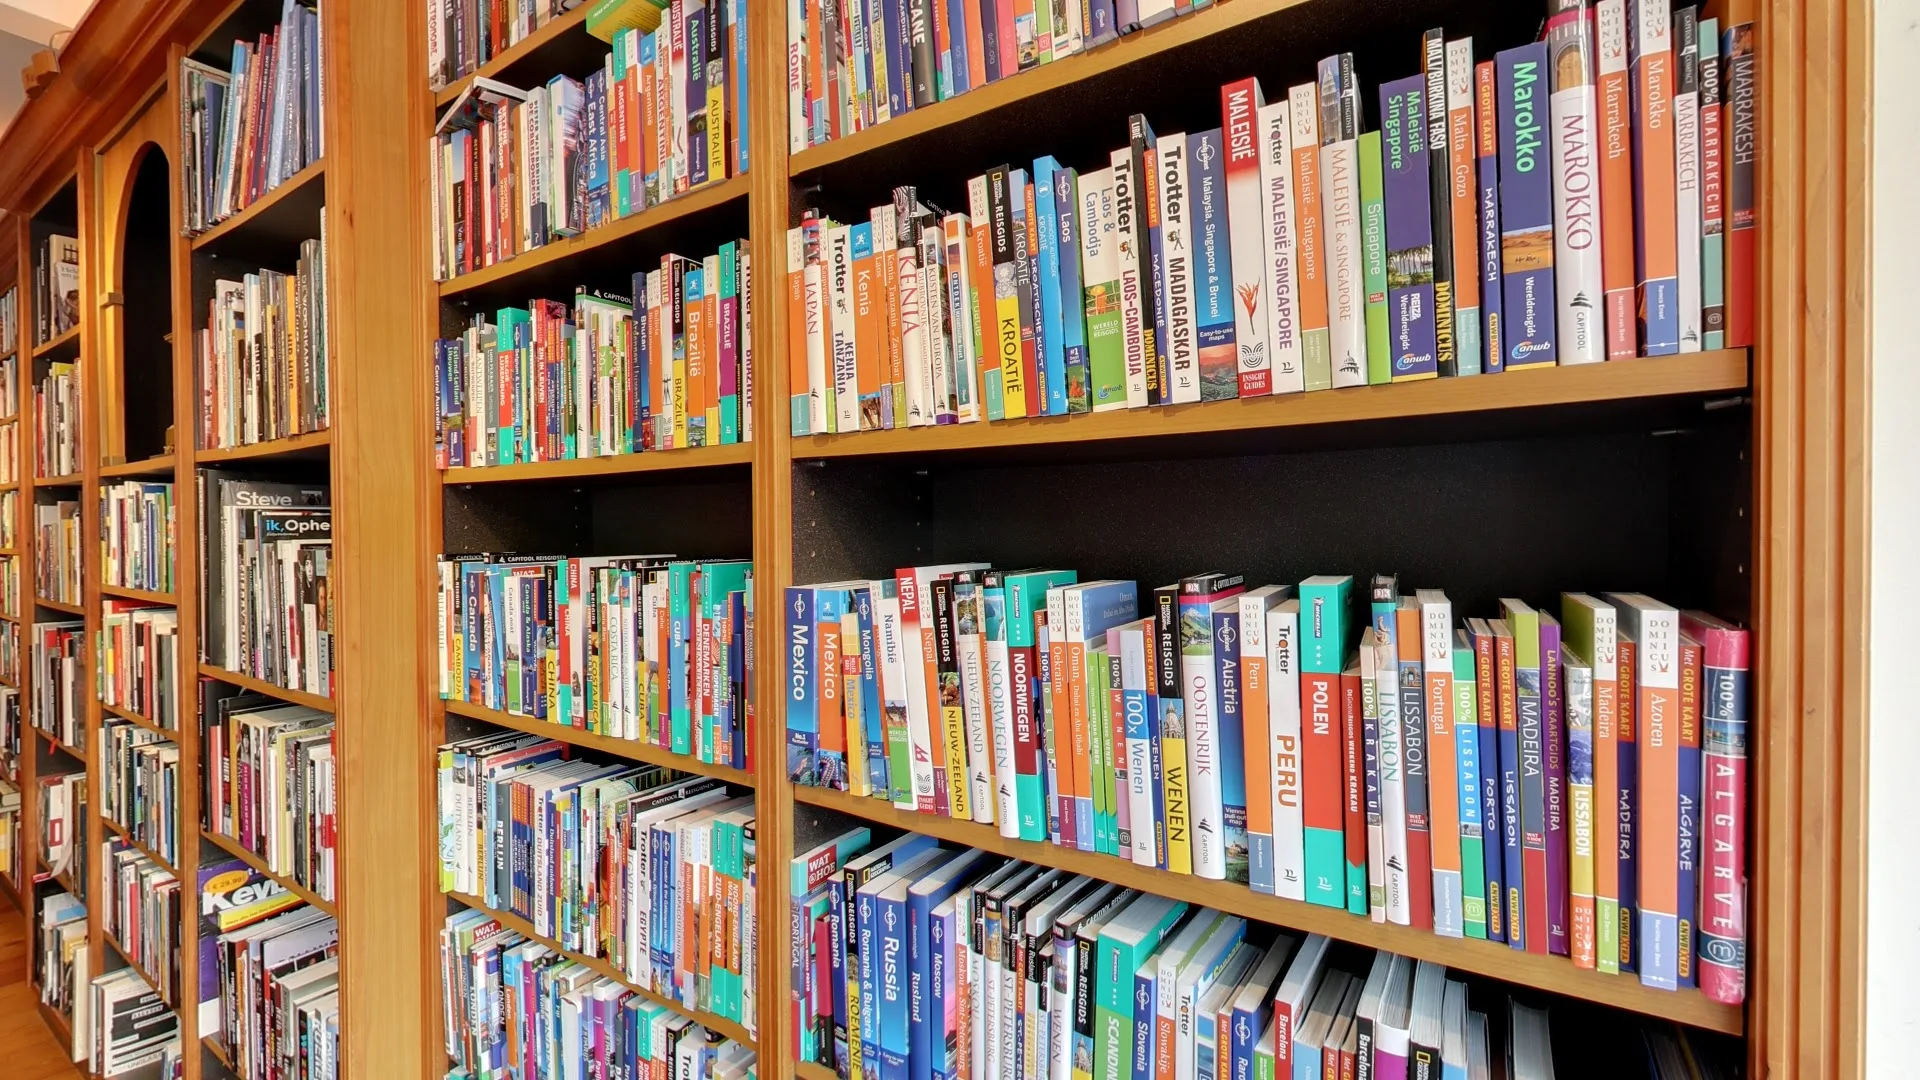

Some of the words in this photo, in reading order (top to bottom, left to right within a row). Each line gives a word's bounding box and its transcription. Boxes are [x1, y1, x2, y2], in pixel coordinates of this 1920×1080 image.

[691, 19, 701, 81] Australië
[791, 43, 799, 92] ROME
[1481, 67, 1489, 83] Met
[588, 102, 596, 135] East
[1482, 85, 1491, 117] GROTE
[1513, 61, 1541, 173] Marokko
[1606, 78, 1626, 160] Marrakech
[1648, 59, 1666, 129] Marokko
[1735, 61, 1754, 165] MARRAKESH
[711, 99, 721, 168] AUSTRALIË
[1229, 89, 1255, 162] MALEISIË
[1270, 115, 1282, 166] Trotter
[1387, 95, 1402, 170] Singapore
[1407, 91, 1423, 153] Maleisië
[1483, 118, 1492, 152] KAART
[1115, 159, 1132, 235] Trotter
[1164, 146, 1181, 224] Trotter
[1203, 176, 1213, 221] Malaysia,
[1562, 114, 1593, 252] MAROKKO
[995, 205, 1006, 253] REISGIDS
[1061, 212, 1071, 243] Laos
[1204, 223, 1217, 275] Singapore
[1367, 204, 1382, 275] Singapore
[1485, 187, 1497, 283] MARRAKECH
[834, 234, 845, 294] Trotter
[1208, 275, 1218, 285] &
[604, 292, 632, 304] CAPITOOL
[805, 283, 818, 335] JAPAN
[858, 269, 869, 316] Kenia
[900, 256, 920, 336] KENIA
[1031, 258, 1042, 332] KROATISCHE
[1169, 257, 1191, 371] MADAGASKAR
[1209, 286, 1220, 318] Brunei
[689, 311, 700, 378] Brazilië
[724, 303, 732, 349] BRAZILIË
[928, 268, 938, 307] KUSTEN
[933, 332, 942, 378] EUROPA
[1435, 281, 1452, 363] DOMINICUS
[1576, 312, 1585, 351] CAPITOOL
[835, 330, 846, 396] TANZANIA
[845, 341, 855, 380] KENIA
[1002, 317, 1021, 395] KROATIË
[1036, 335, 1044, 369] KUST
[1242, 372, 1266, 382] INSIGHT
[674, 378, 684, 431] BRAZILIË
[1244, 380, 1266, 390] GUIDES
[236, 491, 292, 506] Steve
[900, 576, 913, 614] NEPAL
[1314, 600, 1322, 638] MICHELIN
[469, 596, 477, 652] Canada
[939, 617, 950, 663] REISGIDS
[1278, 625, 1289, 675] Trotter
[1481, 639, 1490, 656] Met
[1501, 640, 1509, 656] Met
[702, 623, 710, 697] DENEMARKEN
[793, 624, 809, 701] Mexico
[823, 632, 838, 700] Mexico
[862, 630, 872, 681] Mongolia
[1162, 632, 1174, 688] REISGIDS
[1249, 662, 1259, 690] Peru
[1481, 657, 1490, 691] GROTE
[1500, 657, 1511, 691] GROTE
[1547, 649, 1558, 707] LANNOO'S
[1013, 653, 1030, 744] NOORWEGEN
[1222, 659, 1236, 714] Austria
[1312, 681, 1330, 736] POLEN
[1431, 678, 1449, 736] Portugal
[1482, 692, 1492, 724] KAART
[1502, 692, 1512, 726] KAART
[1599, 686, 1611, 740] Madeira
[1719, 673, 1735, 717] 100%
[990, 660, 1008, 769] NOORWEGEN
[1192, 675, 1211, 776] OOSTENRIJK
[1378, 692, 1400, 783] LISSABON
[1403, 692, 1424, 777] LISSABON
[1521, 701, 1540, 778] MADEIRA
[1549, 707, 1559, 771] KAARTGIDS
[1651, 693, 1666, 748] Azoren
[948, 710, 963, 812] NIEUW-ZEELAND
[1132, 742, 1144, 795] Wenen
[1151, 735, 1159, 781] WENEN
[1276, 734, 1297, 809] PERU
[651, 793, 678, 806] CAPITOOL
[1167, 766, 1185, 842] WENEN
[1485, 777, 1496, 832] PORTO
[1505, 770, 1517, 848] LISSABON
[1550, 776, 1561, 833] MADEIRA
[1574, 790, 1591, 857] LISSABON
[1619, 788, 1631, 861] MADEIRA
[496, 820, 504, 870] BERLIJN
[1679, 794, 1692, 871] ALGARVE
[1715, 762, 1734, 930] ALGARVE
[831, 914, 840, 969] Romania
[848, 902, 856, 944] REISGIDS
[862, 928, 870, 976] Romania
[885, 936, 899, 1002] Russia
[934, 953, 943, 999] Moscow
[863, 978, 871, 991] &
[1077, 974, 1087, 1025] REISGIDS
[863, 992, 873, 1039] Bulgaria
[1053, 1008, 1062, 1064] WENEN
[1181, 995, 1191, 1036] Trotter
[1279, 1014, 1288, 1060] Barcelona
[1137, 1021, 1148, 1071] Slovenia
